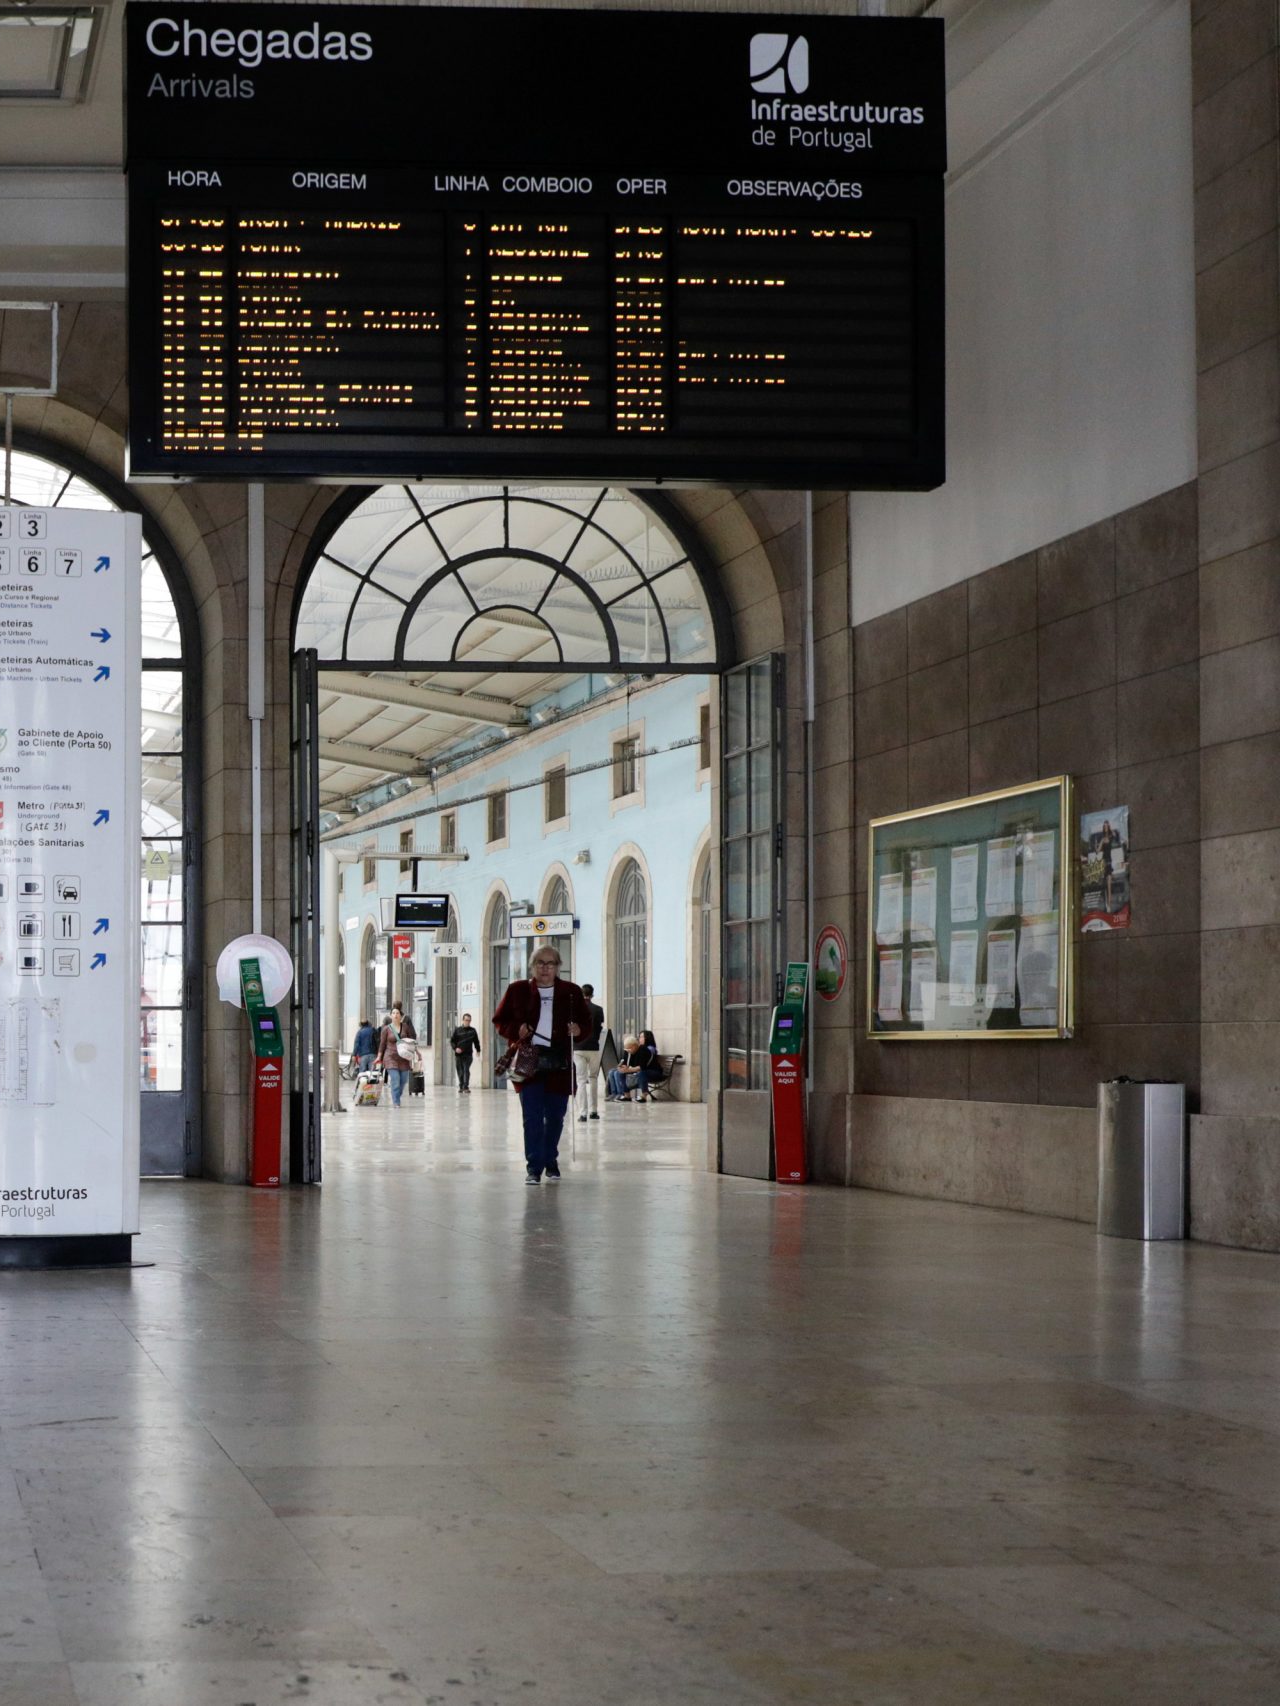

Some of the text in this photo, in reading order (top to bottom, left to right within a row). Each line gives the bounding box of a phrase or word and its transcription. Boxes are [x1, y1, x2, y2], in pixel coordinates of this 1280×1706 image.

[144, 19, 374, 67] Chegadas
[147, 72, 255, 100] Arrivals
[751, 99, 924, 124] Infraestruturas
[751, 126, 872, 152] de Portugal
[168, 171, 863, 201] HORA ORIGEM LINHA COMBOIO OPER OBSERVAÇÕES
[27, 520, 39, 537] 3
[27, 556, 39, 573] 6
[64, 559, 74, 575] 7
[36, 656, 94, 667] Automáticas
[18, 728, 104, 741] Gabinete de Apoio
[32, 739, 65, 748] Cliente
[68, 739, 95, 750] (Porta
[98, 740, 112, 750] 50)
[17, 802, 45, 810] Metro
[38, 838, 85, 848] Sanitarias
[517, 922, 532, 931] Stop
[1, 1204, 55, 1220] Portugal
